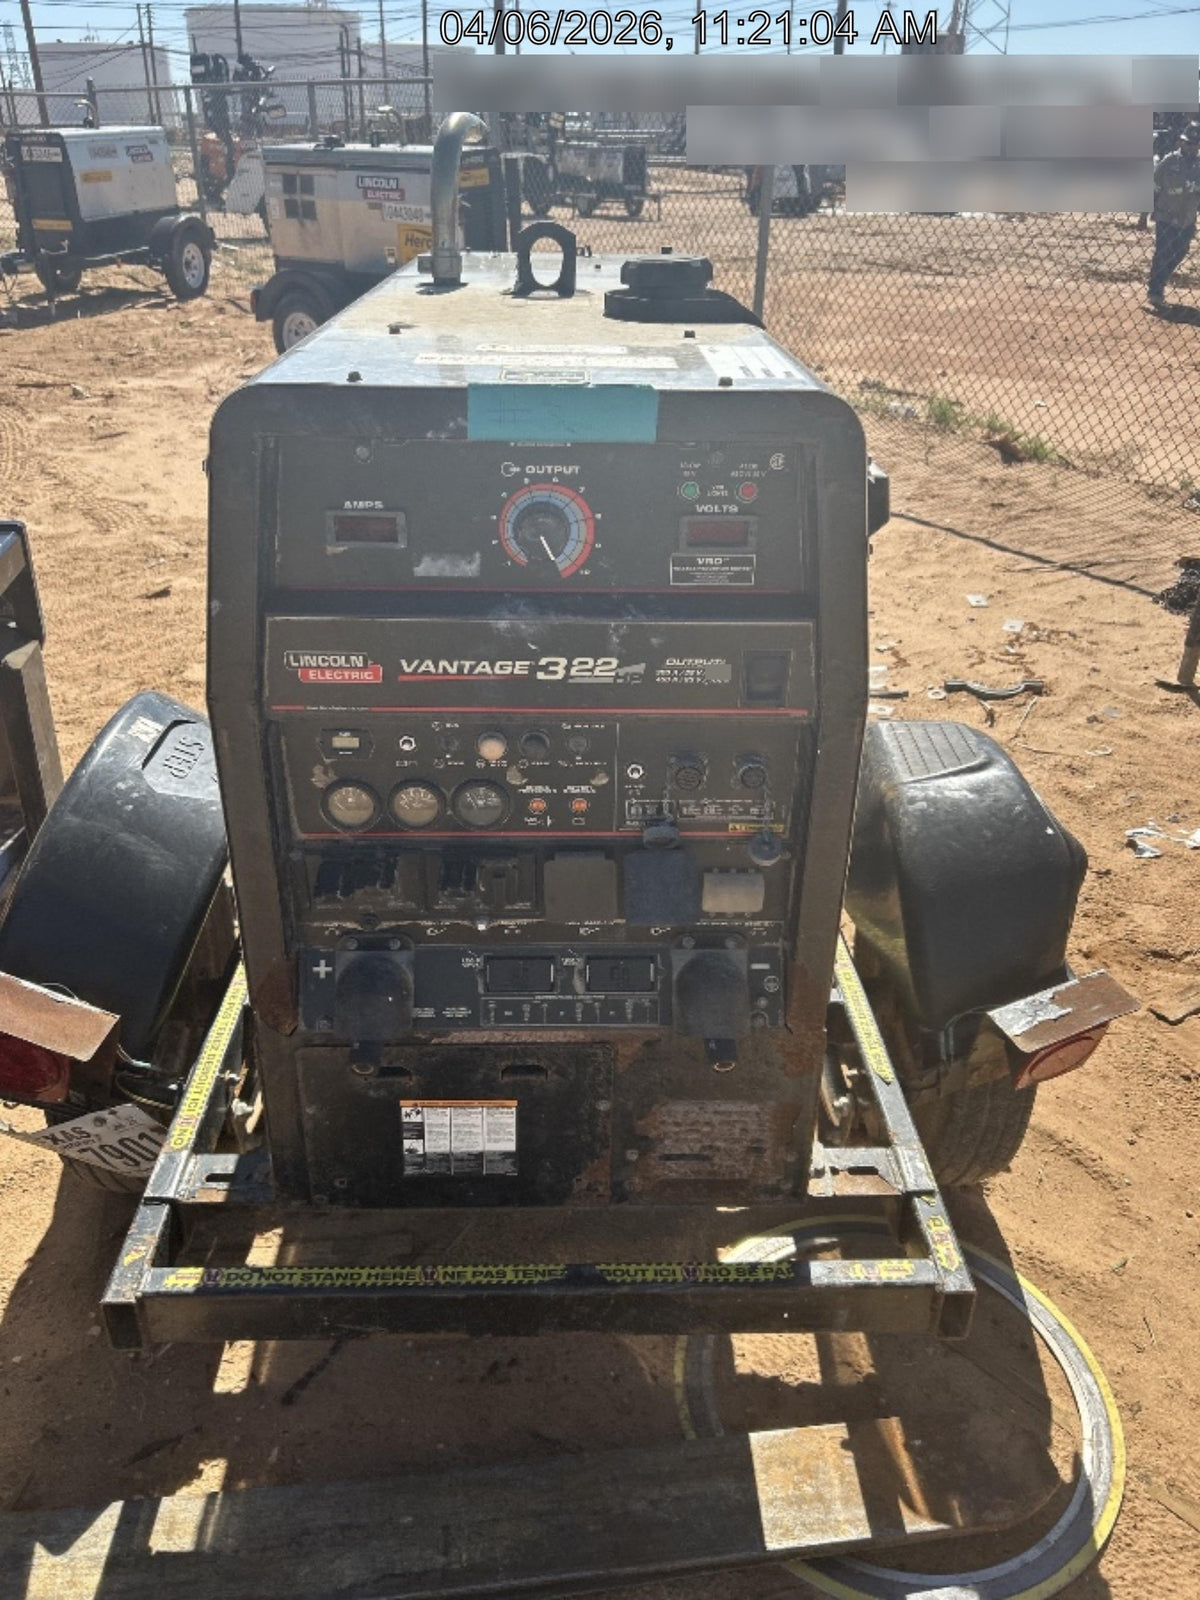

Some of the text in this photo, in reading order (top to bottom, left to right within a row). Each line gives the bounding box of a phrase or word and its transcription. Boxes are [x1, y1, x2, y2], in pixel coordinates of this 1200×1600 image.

[358, 177, 398, 189] LINCOLN
[367, 190, 402, 200] ELECTRIC
[525, 465, 581, 475] OUTPUT
[343, 500, 385, 510] AMPS
[695, 504, 740, 513] VOLTS
[289, 655, 365, 668] LINCOLN
[400, 658, 531, 675] VANTAGE
[536, 656, 620, 680] 322
[307, 670, 375, 681] ELECTRIC
[42, 1126, 92, 1146] XAS
[172, 1125, 188, 1147] NO
[225, 1272, 252, 1282] DO
[255, 1271, 297, 1281] NOT
[300, 1271, 362, 1281] STAND
[366, 1271, 417, 1281] HERE
[442, 1270, 467, 1280] NE
[472, 1269, 507, 1280] PAS
[654, 1268, 676, 1277] ICI
[703, 1267, 731, 1277] NO
